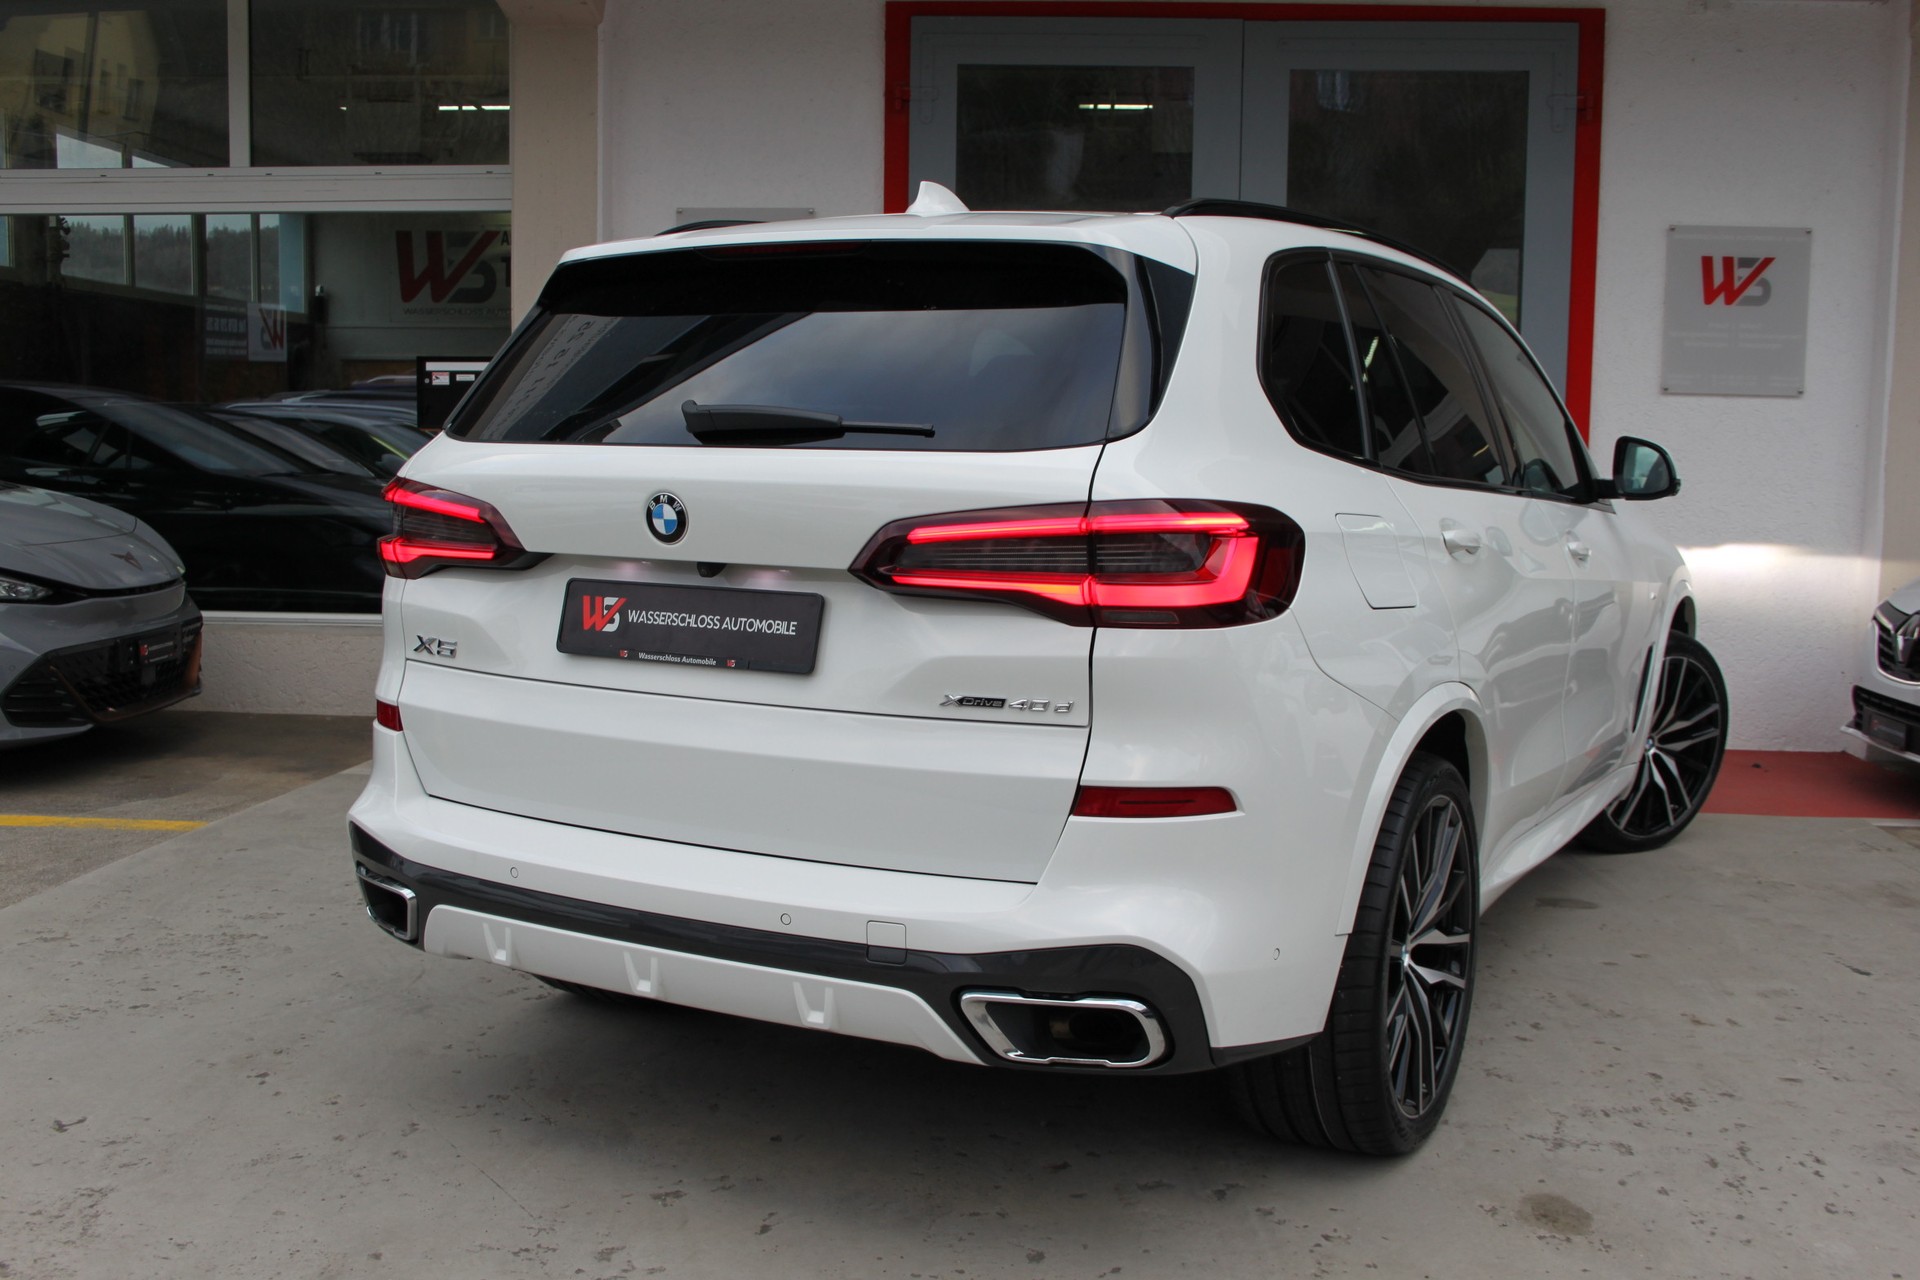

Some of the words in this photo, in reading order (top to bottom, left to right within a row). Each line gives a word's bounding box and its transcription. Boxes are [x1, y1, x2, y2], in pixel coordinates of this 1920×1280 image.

[649, 494, 682, 512] BMW
[628, 609, 720, 630] WASSERSCHLOSS
[722, 615, 798, 636] AUTOMOBILE
[413, 634, 458, 659] X5
[638, 651, 681, 663] Wasserschloss
[681, 655, 717, 666] Automobile
